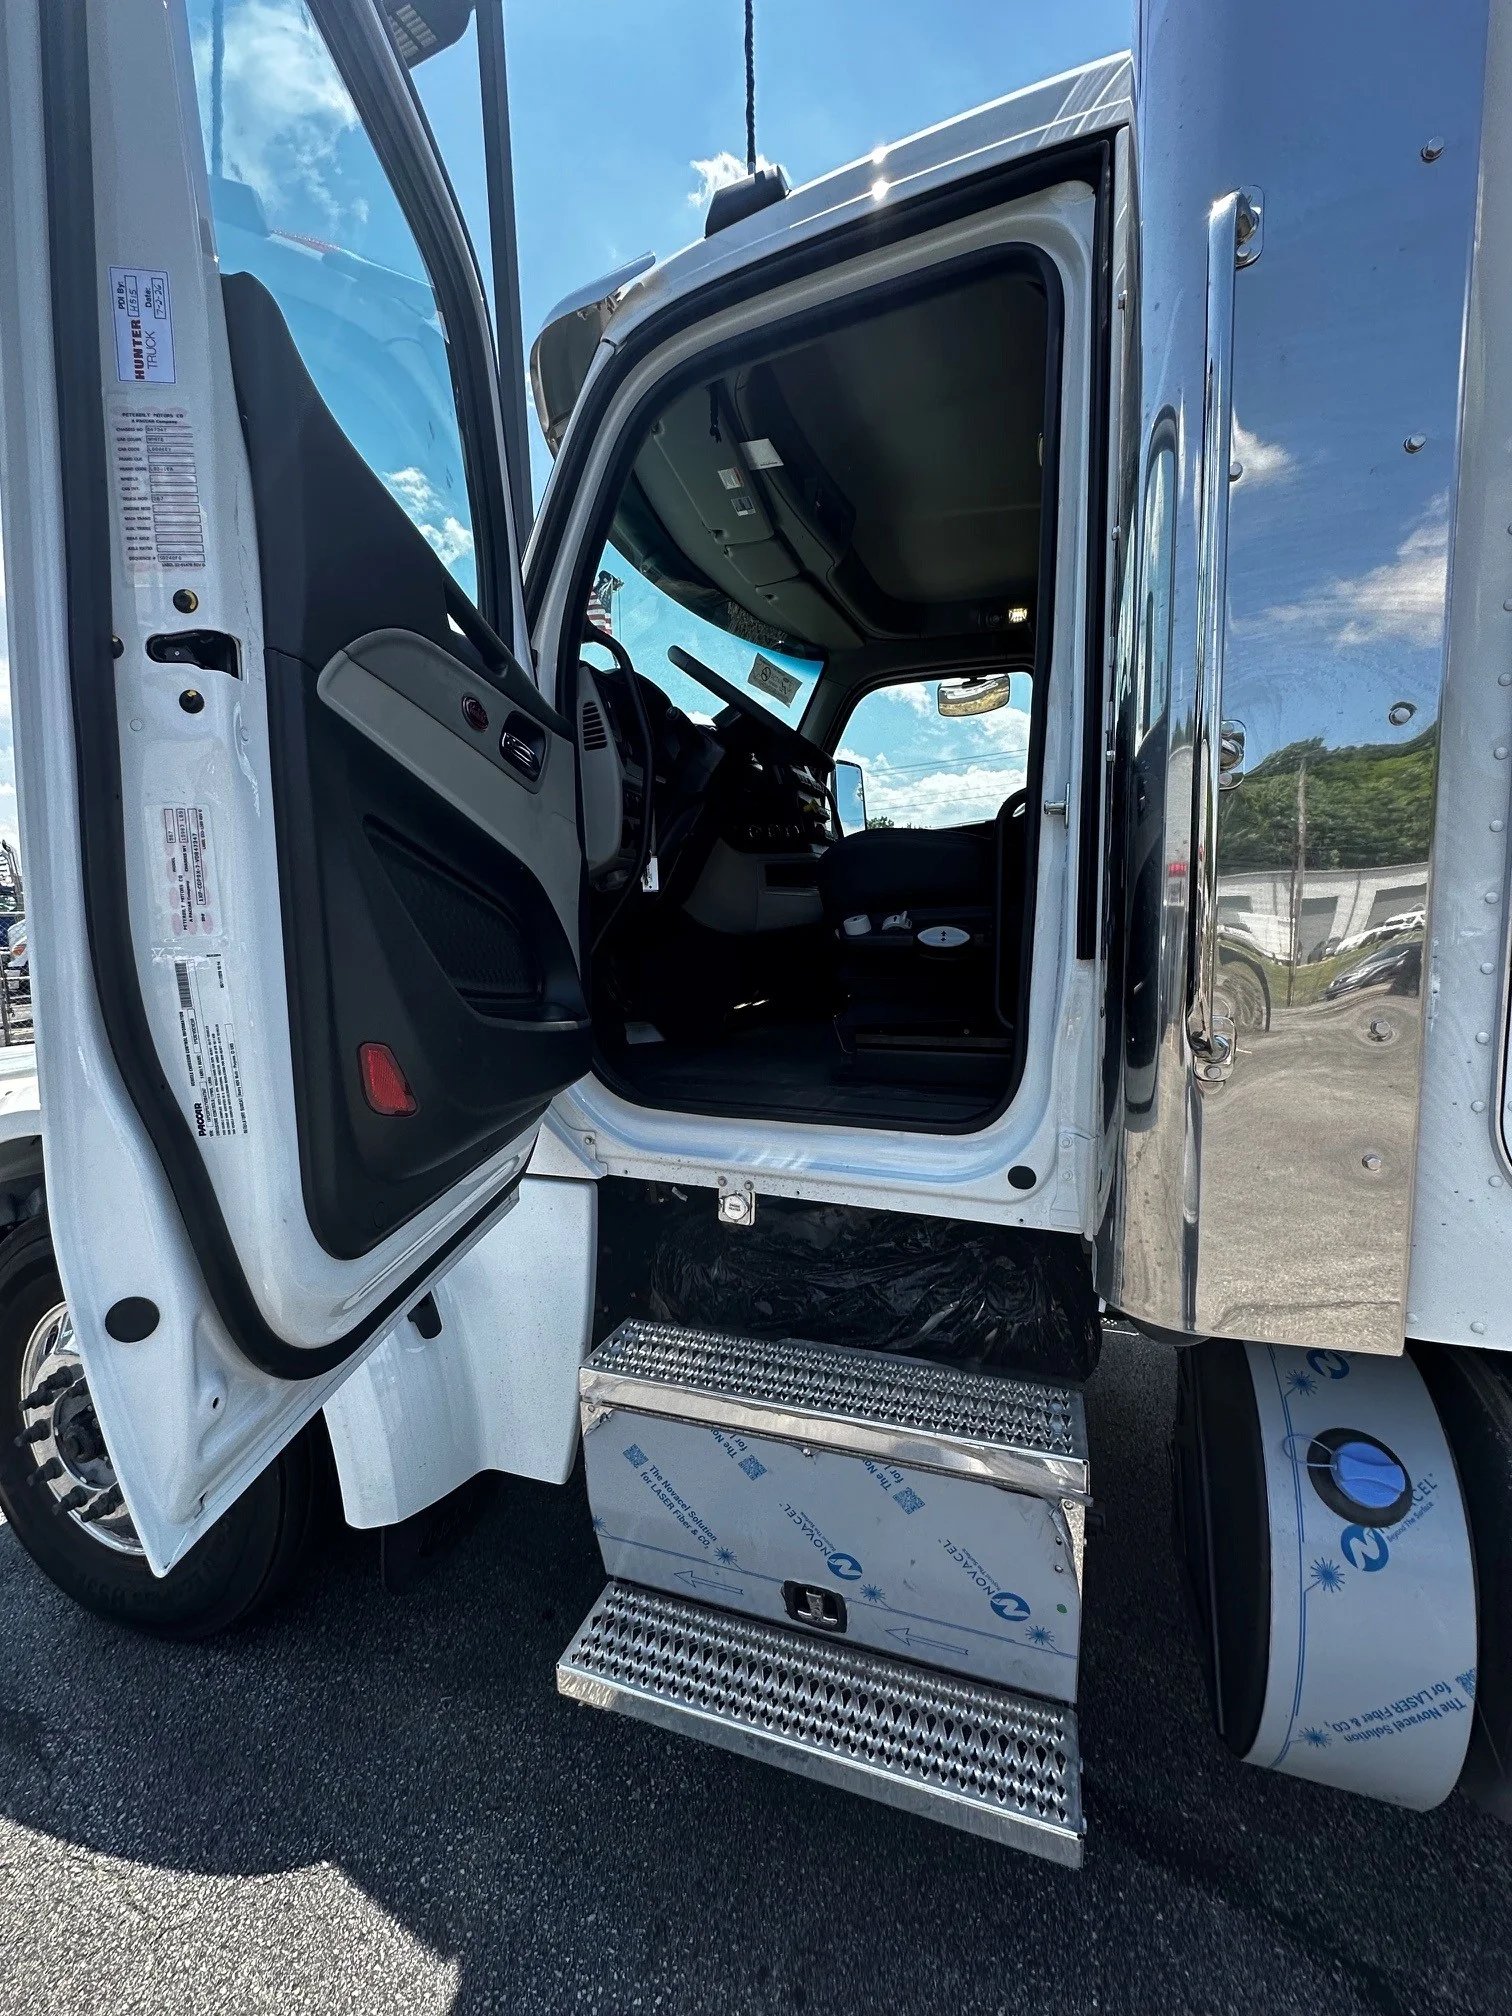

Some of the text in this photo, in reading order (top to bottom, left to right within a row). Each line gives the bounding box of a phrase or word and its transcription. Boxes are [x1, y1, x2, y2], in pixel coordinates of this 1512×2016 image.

[116, 281, 126, 310] PDI By:
[131, 320, 145, 380] HUNTER
[145, 331, 158, 369] TRUCK
[194, 1103, 206, 1136] PACCAR
[723, 1442, 737, 1459] The
[735, 1439, 748, 1451] for
[877, 1473, 892, 1491] The
[890, 1470, 904, 1483] for
[640, 1472, 652, 1485] for
[650, 1484, 675, 1510] LASER
[672, 1509, 692, 1529] Fiber
[650, 1465, 717, 1541] The Novacel Solution
[1405, 1518, 1416, 1527] The
[1413, 1502, 1434, 1519] Surface
[784, 1504, 831, 1556] NOVACEL
[944, 1539, 995, 1595] NOVACEL
[1431, 1681, 1452, 1695] for
[1362, 1706, 1393, 1723] Fiber
[1390, 1690, 1433, 1714] LASER
[1344, 1697, 1467, 1742] The Novacel Solution
[1350, 1717, 1361, 1727] &
